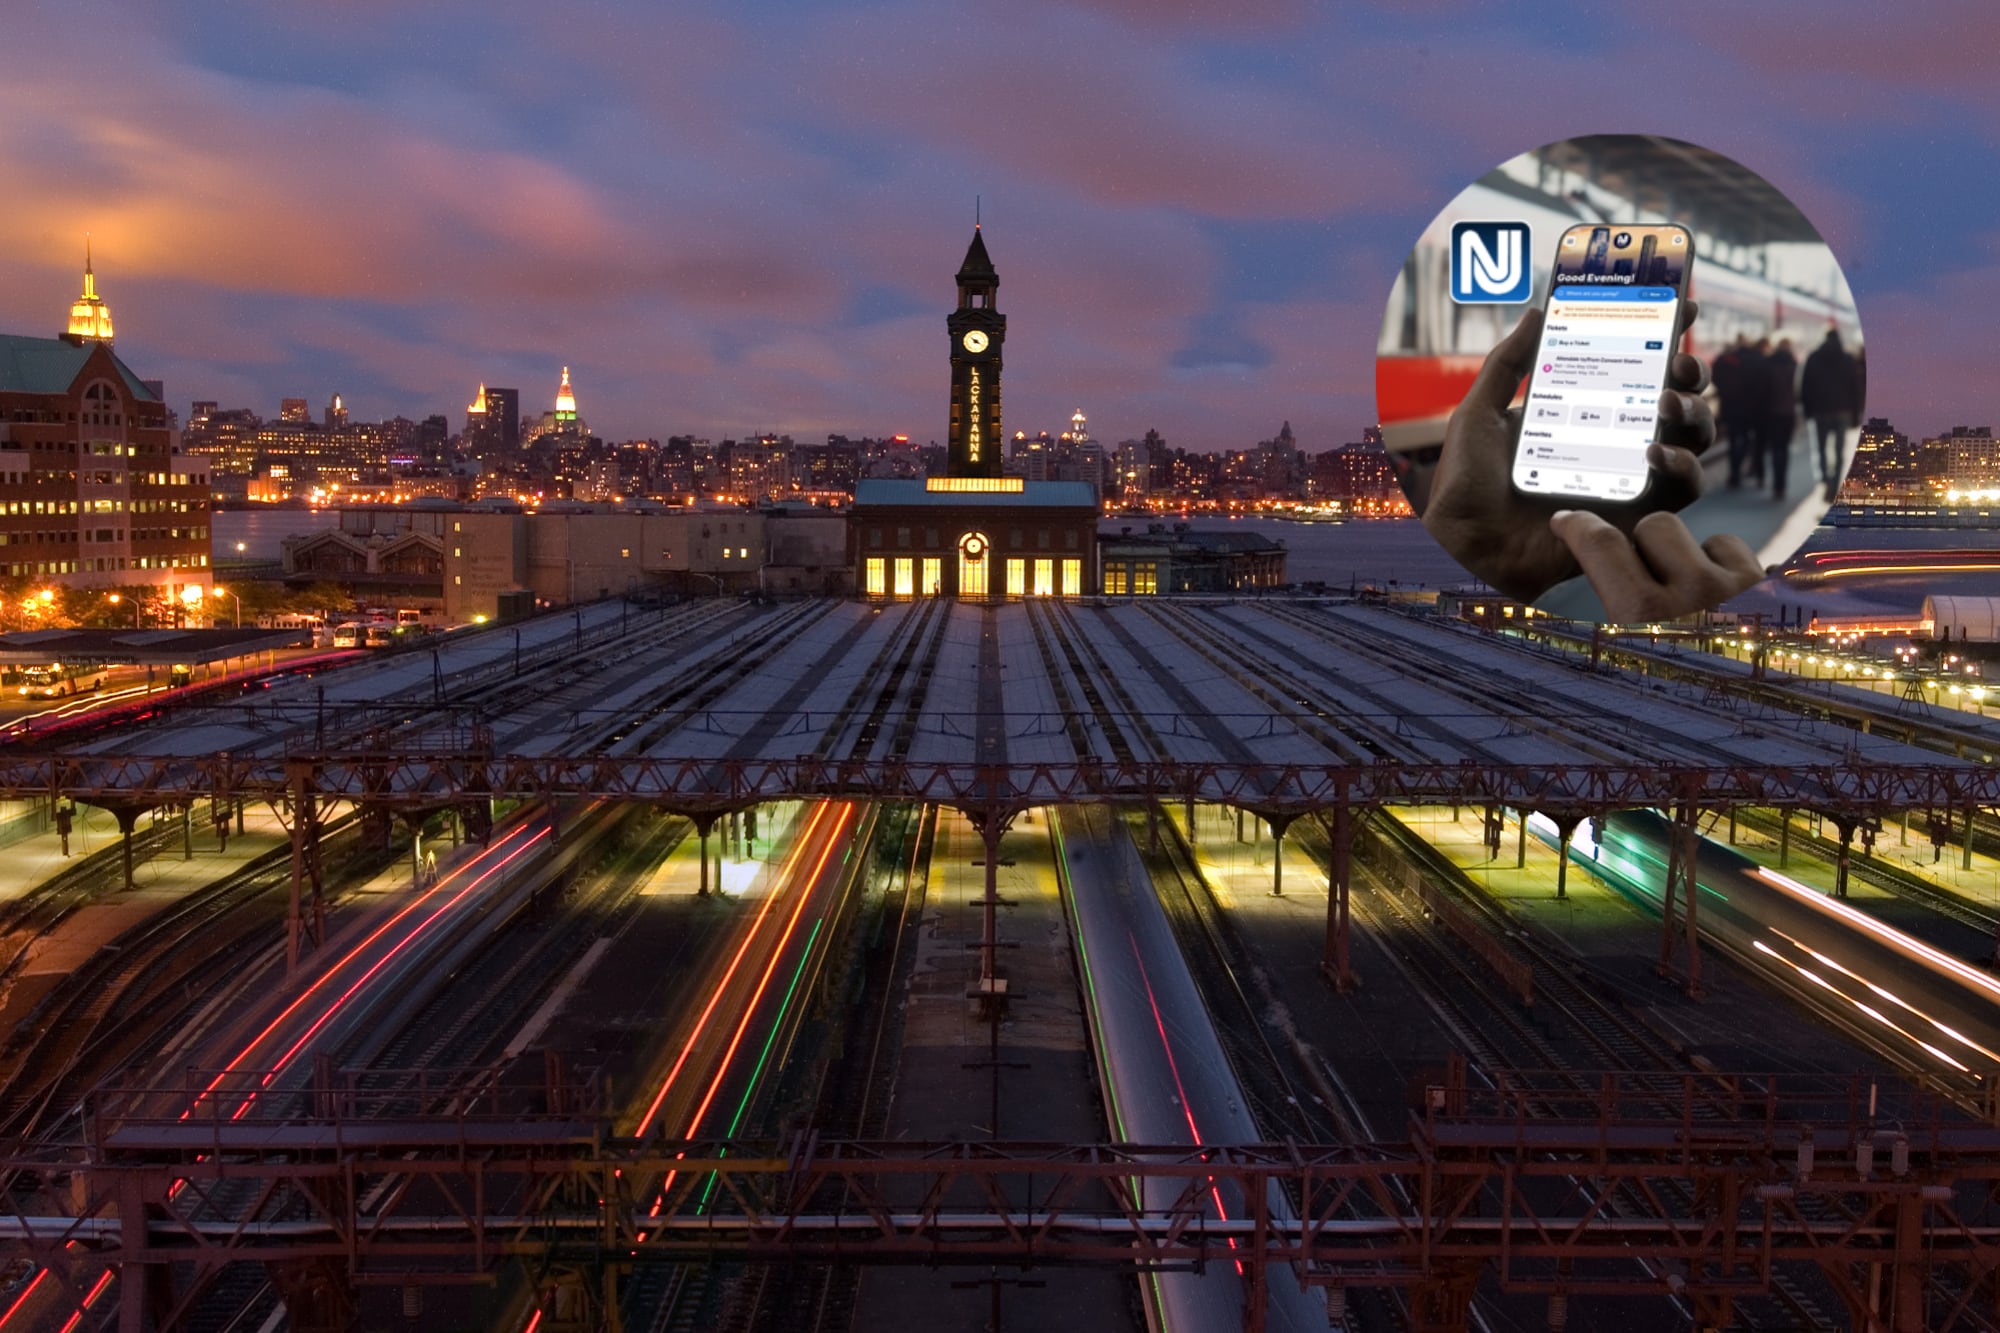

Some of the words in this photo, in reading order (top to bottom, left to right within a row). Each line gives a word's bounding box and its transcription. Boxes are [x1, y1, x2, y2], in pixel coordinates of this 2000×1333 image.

[1557, 273, 1585, 283] Good
[1587, 273, 1636, 284] Evening!
[970, 367, 981, 462] LACKAWANNA
